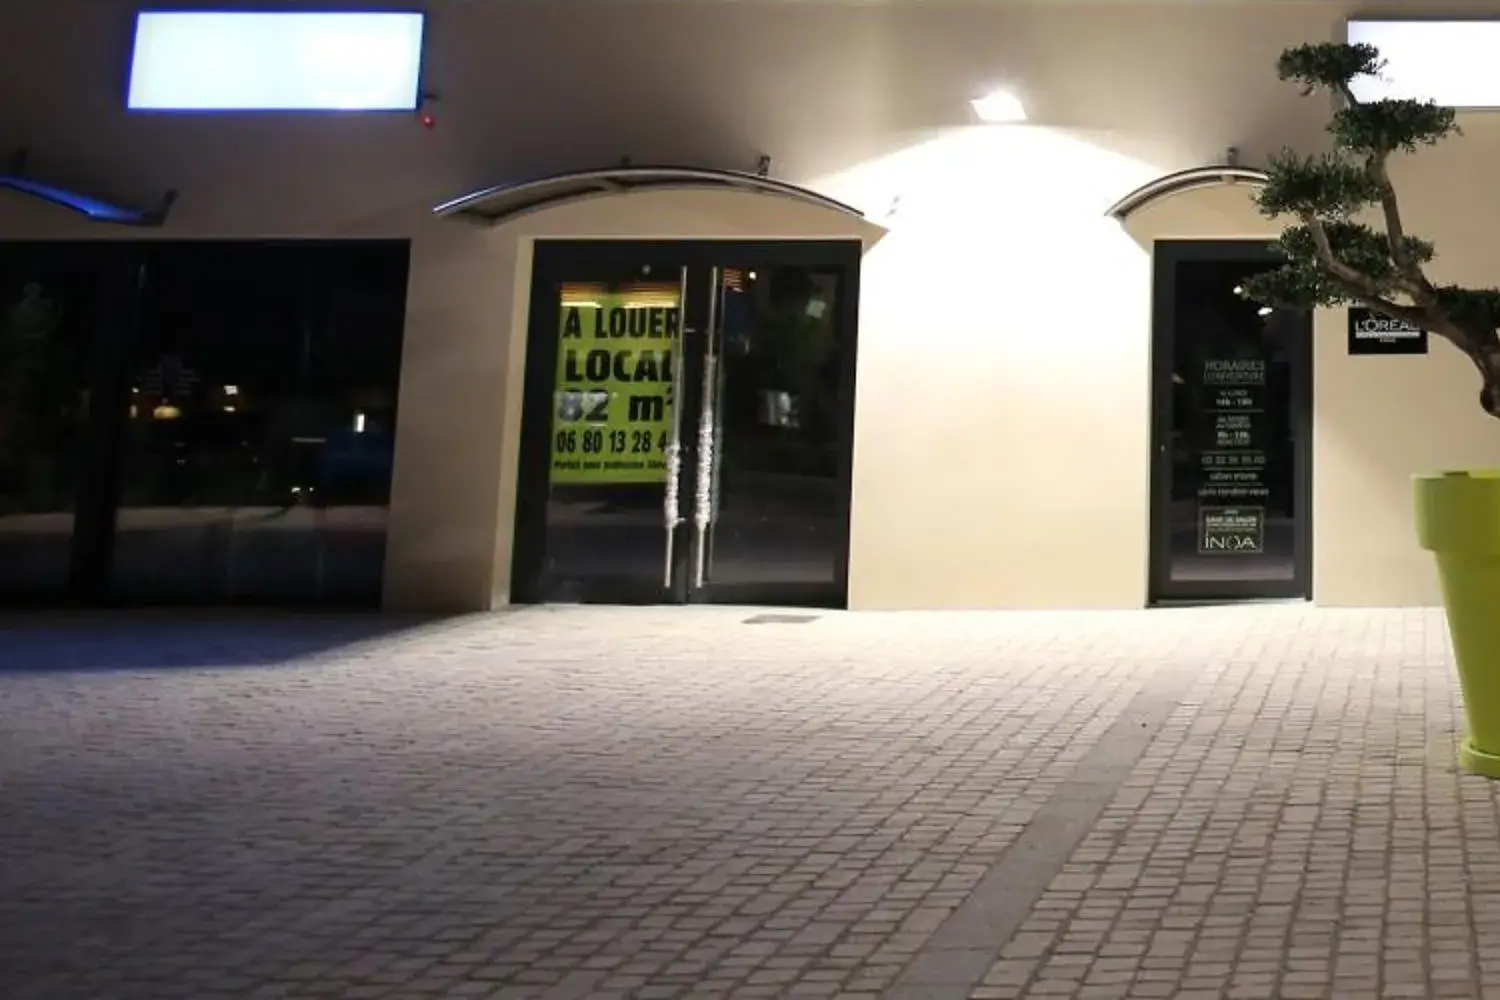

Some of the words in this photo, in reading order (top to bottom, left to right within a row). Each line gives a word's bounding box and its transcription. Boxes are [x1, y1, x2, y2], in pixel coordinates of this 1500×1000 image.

[563, 308, 582, 339] A
[594, 307, 680, 339] LOUER
[583, 430, 604, 454] 80
[609, 430, 626, 452] 13
[631, 429, 653, 452] 28
